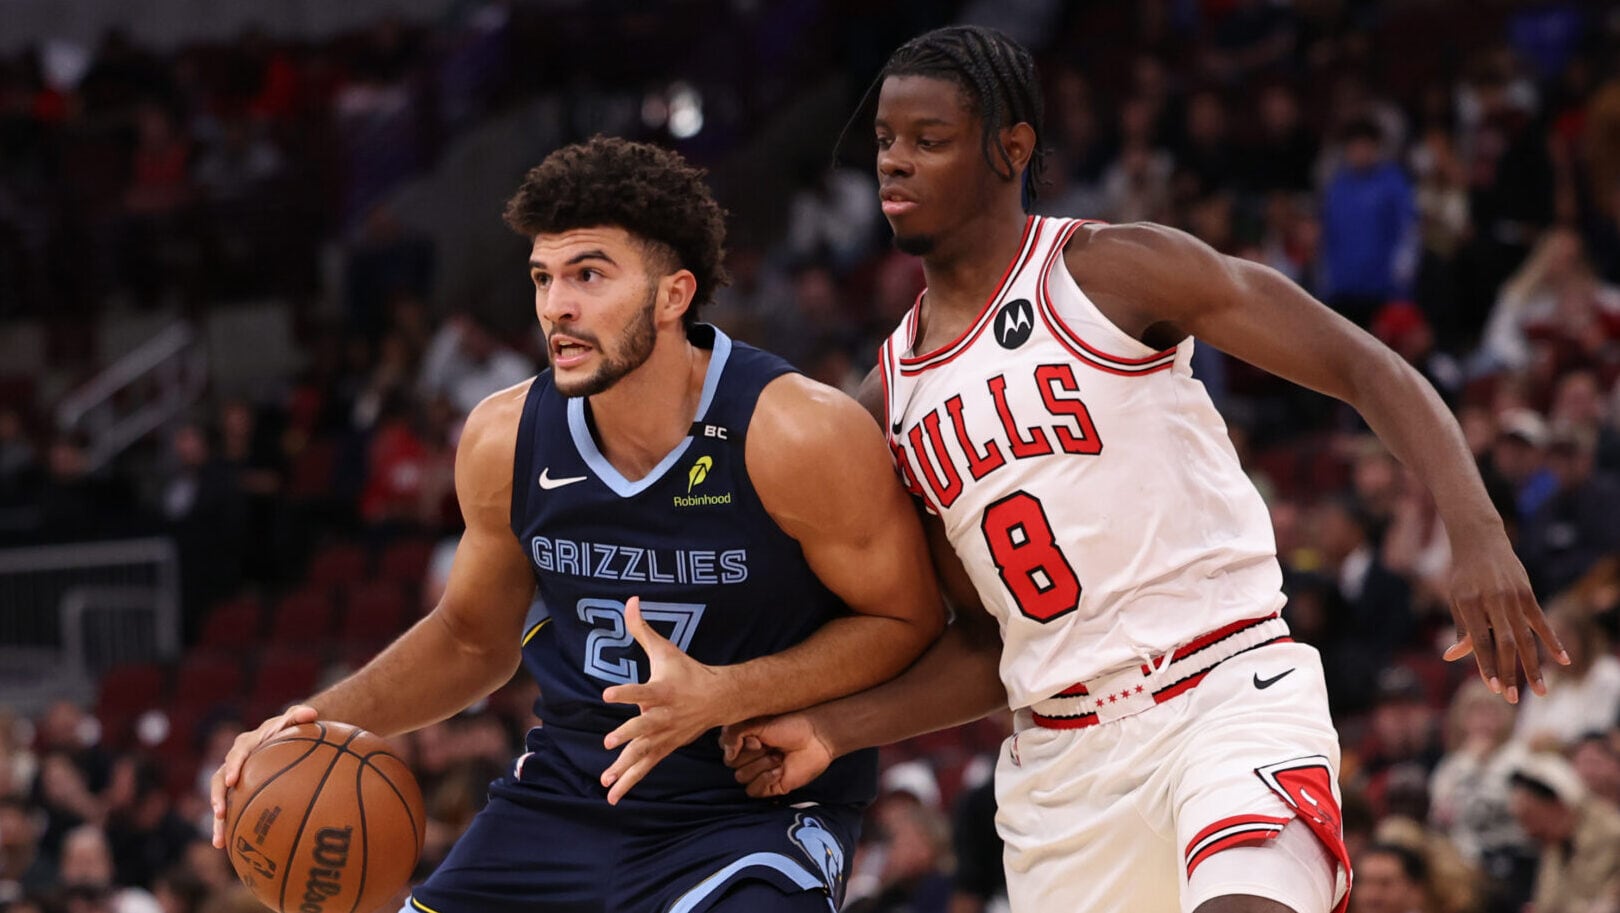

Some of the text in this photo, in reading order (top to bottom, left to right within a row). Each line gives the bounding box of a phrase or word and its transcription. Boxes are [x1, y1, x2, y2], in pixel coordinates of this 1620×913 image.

[704, 424, 728, 441] BC
[673, 492, 732, 508] Robinhood
[531, 535, 749, 585] GRIZZLIES
[981, 489, 1082, 624] 8
[576, 597, 707, 685] 27
